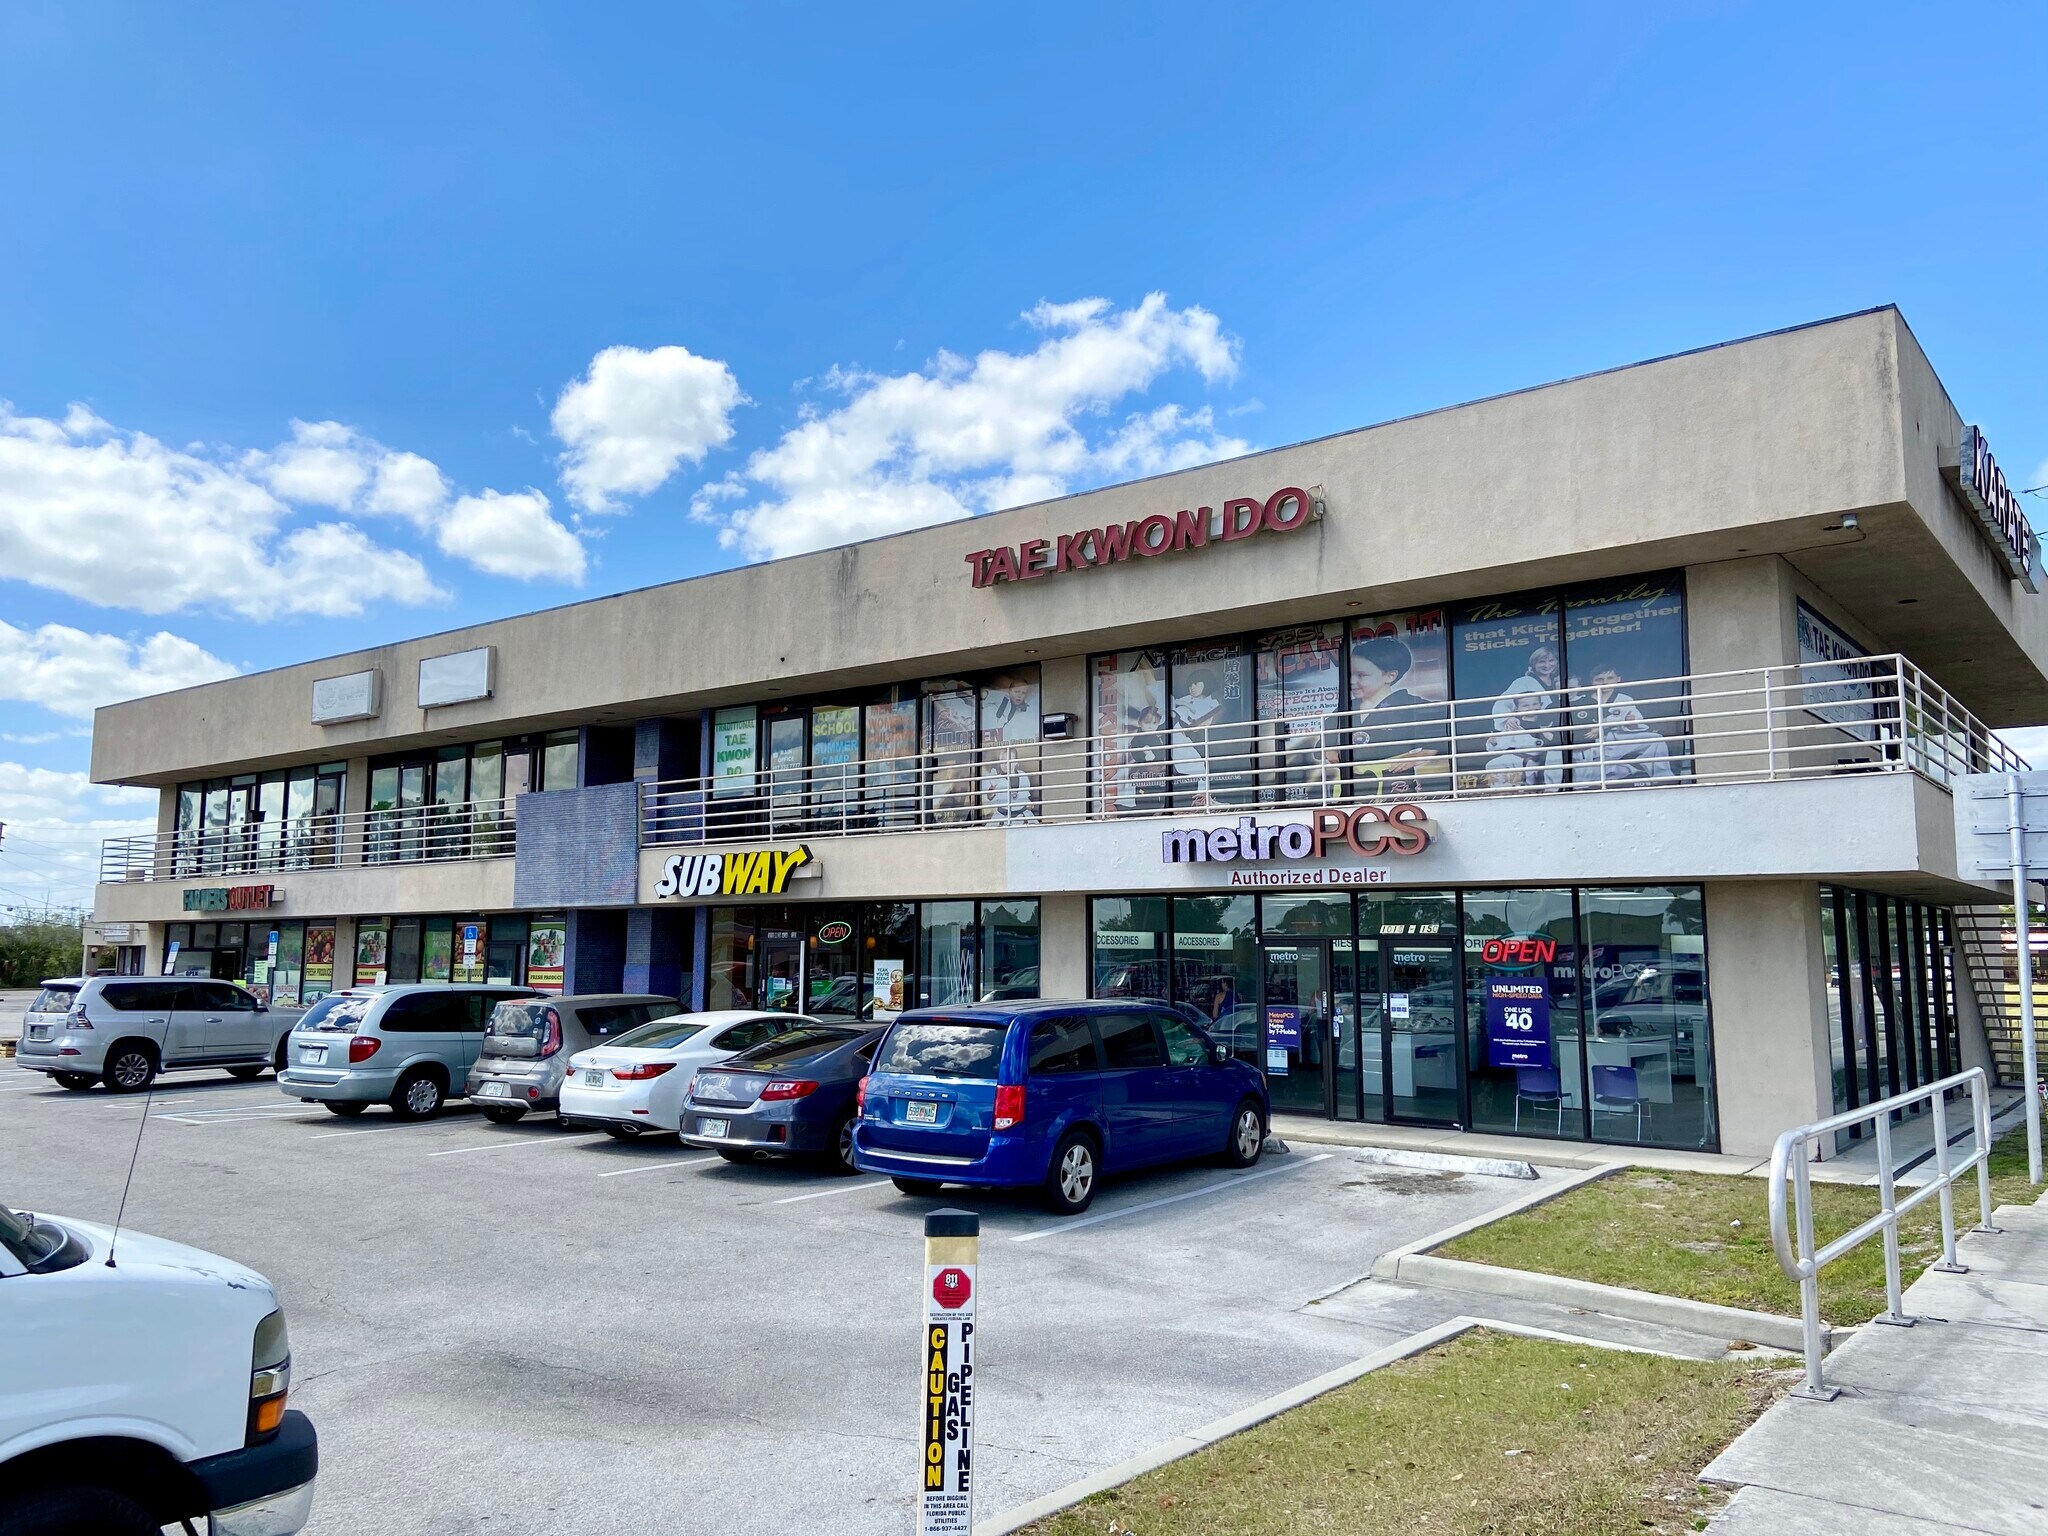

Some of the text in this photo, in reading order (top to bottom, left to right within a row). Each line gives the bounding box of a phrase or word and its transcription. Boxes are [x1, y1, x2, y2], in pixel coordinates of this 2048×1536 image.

[1973, 425, 2031, 576] KARATE
[965, 486, 1314, 589] TAE KWON DO
[1466, 602, 1523, 623] The
[1464, 629, 1506, 642] that
[1577, 605, 1682, 627] Together
[1256, 624, 1325, 651] YES!
[1464, 620, 1642, 653] Sticks Together!
[813, 721, 859, 738] SCHOOL
[724, 733, 747, 747] TAE
[813, 739, 858, 755] SUMMER
[716, 747, 751, 763] KWON
[821, 755, 850, 766] CAMP
[1162, 803, 1428, 864] metroPCS
[654, 844, 813, 899] SUBWAY
[1231, 867, 1387, 886] Authorized Dealer
[183, 884, 272, 912] FARMERS OUTLET
[822, 926, 847, 938] OPEN
[1178, 936, 1220, 947] ACCESSORIES
[1270, 951, 1299, 961] metro
[1393, 952, 1426, 963] metro
[1482, 939, 1557, 964] OPEN
[1491, 984, 1543, 994] UNLIMITED
[1504, 1012, 1533, 1030] $40
[945, 1273, 958, 1284] 811
[927, 1327, 946, 1488] CAUTION
[946, 1372, 960, 1441] GAS
[957, 1322, 974, 1492] PIPELINE
[946, 1494, 967, 1502] DIGGING
